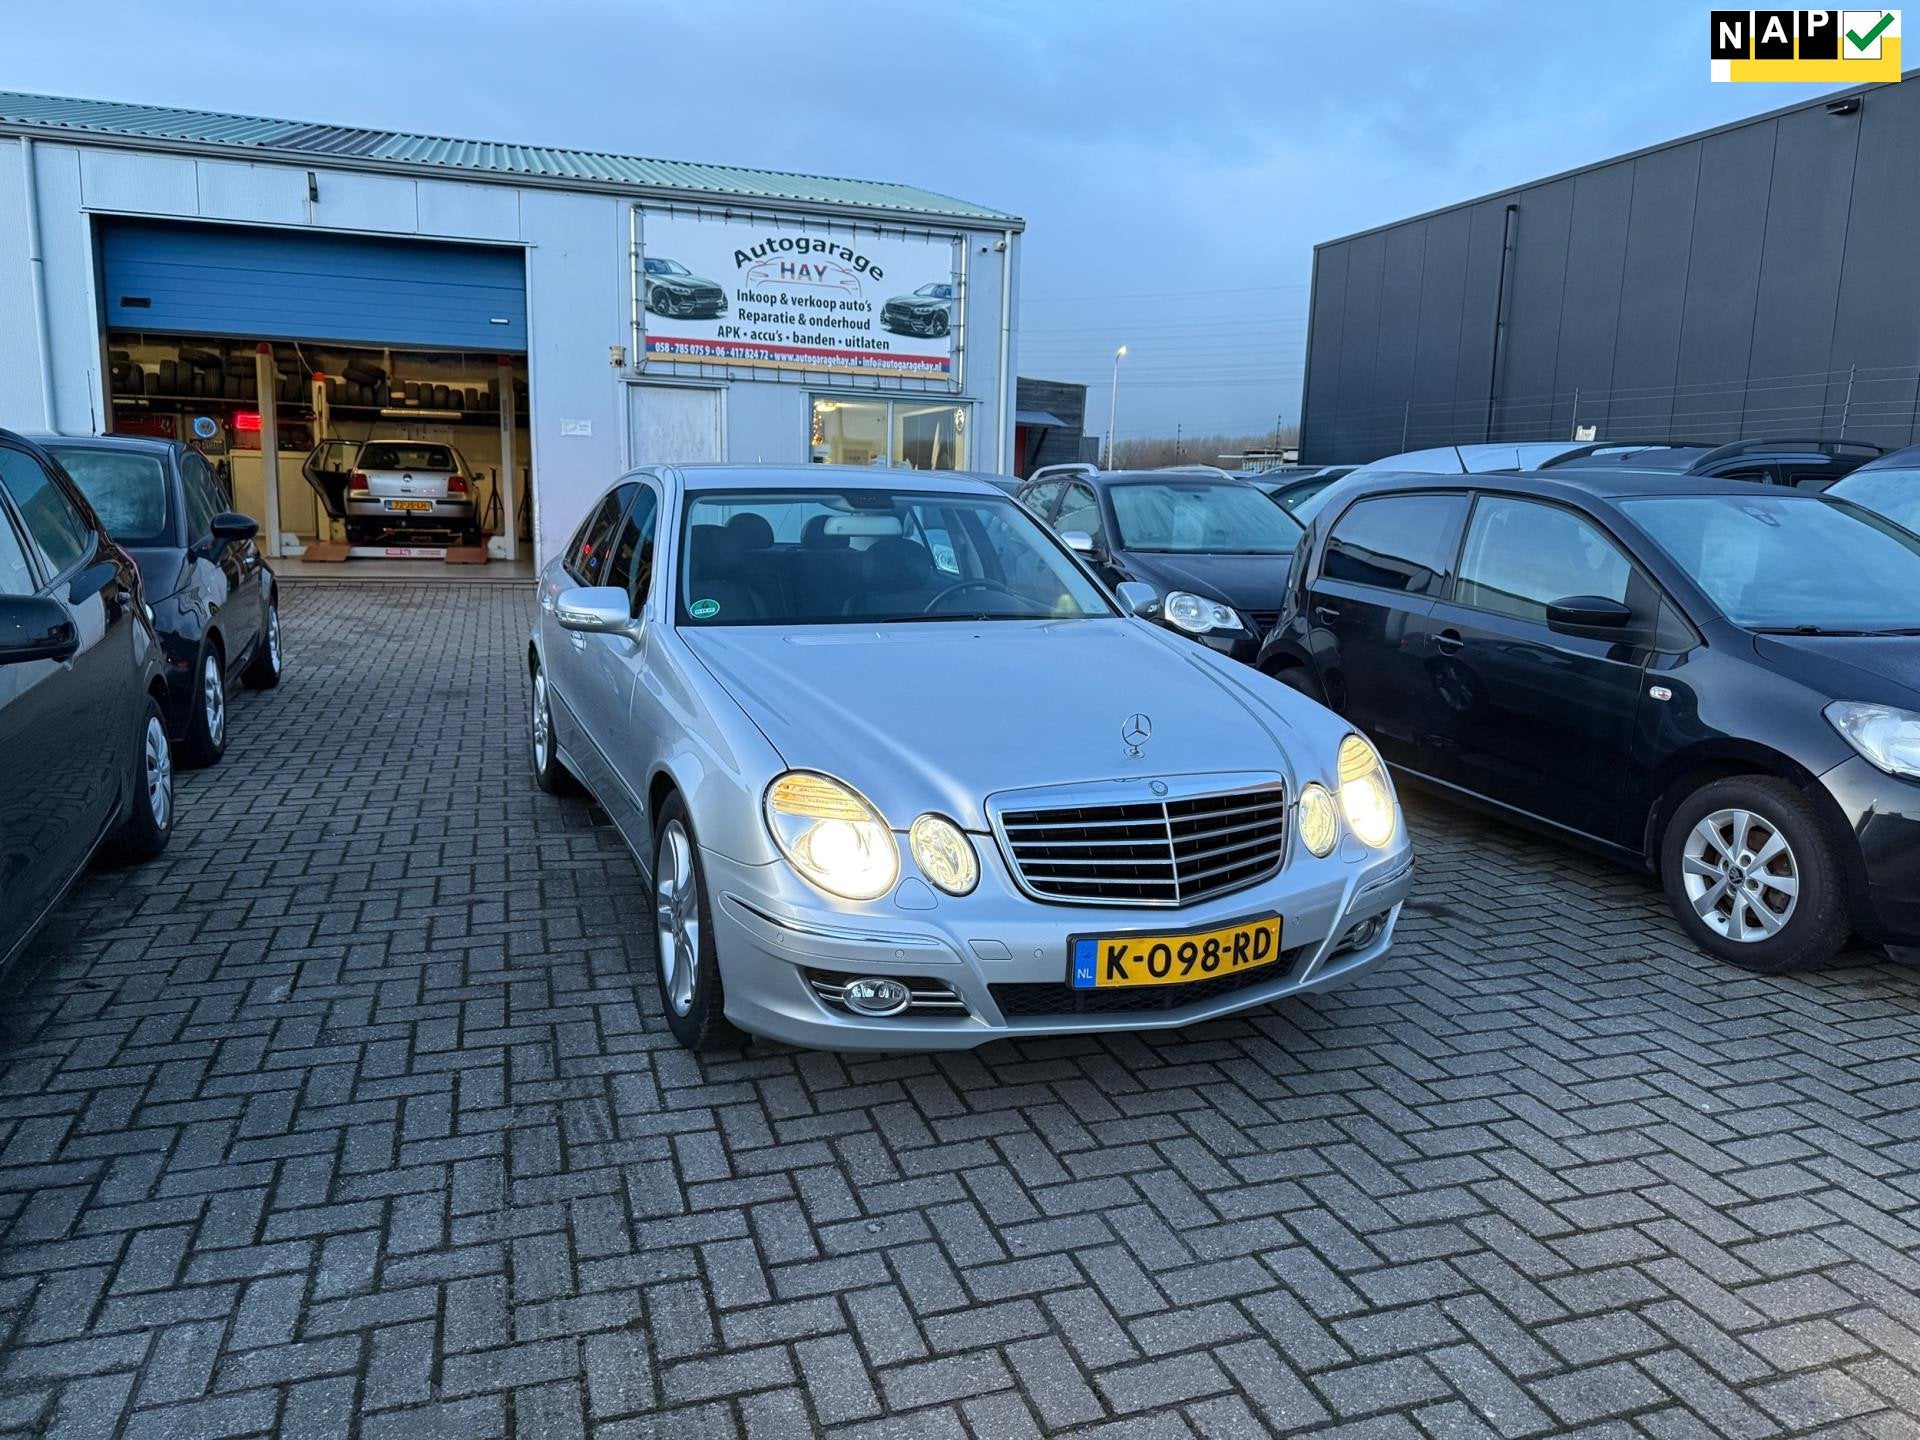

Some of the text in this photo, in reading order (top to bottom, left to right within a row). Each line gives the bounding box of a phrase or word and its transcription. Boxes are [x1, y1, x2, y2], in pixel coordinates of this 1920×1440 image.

[734, 237, 884, 282] Autogarage
[780, 262, 828, 282] HAY
[737, 289, 872, 312] Inkoop & verkoop auto's
[738, 308, 871, 330] Reparatie & onderhoud
[655, 342, 670, 352] 058
[717, 325, 890, 350] APK accu's banden uitlaten
[1077, 927, 1271, 980] NL K-098-RD
